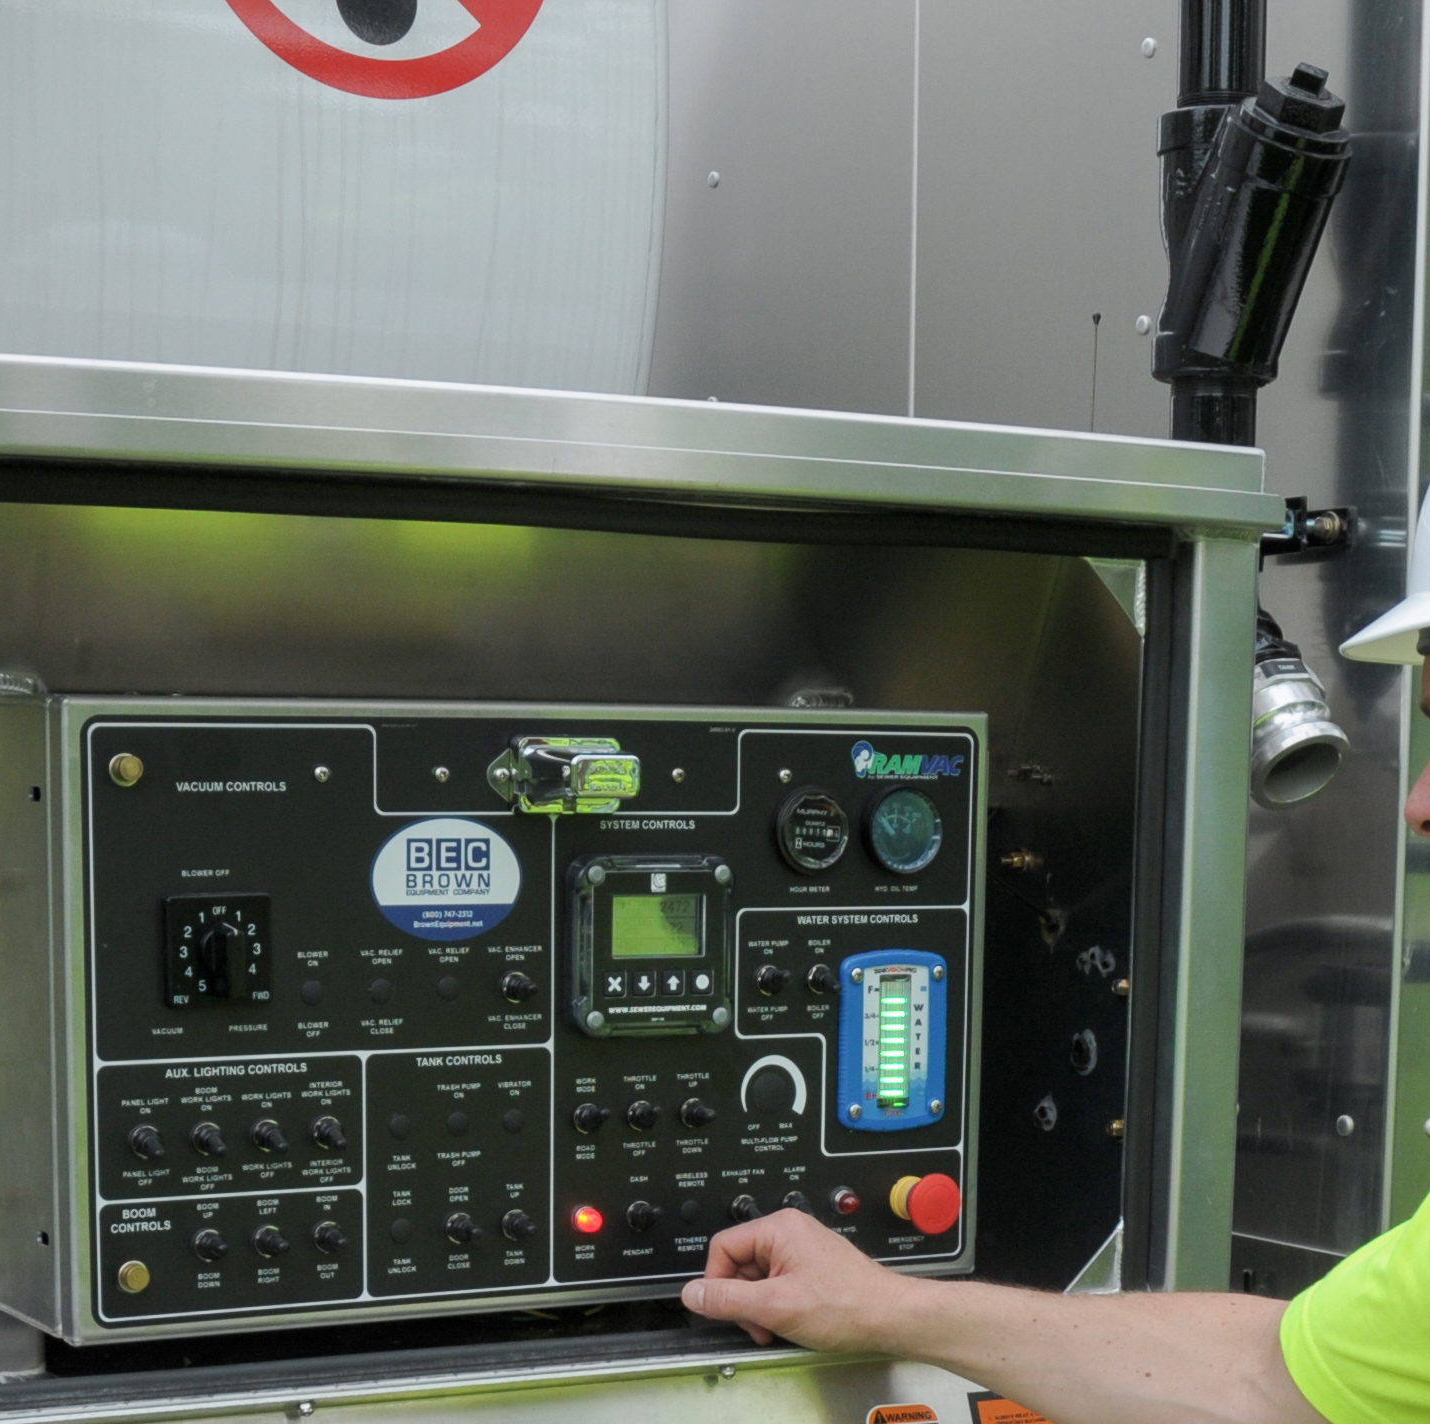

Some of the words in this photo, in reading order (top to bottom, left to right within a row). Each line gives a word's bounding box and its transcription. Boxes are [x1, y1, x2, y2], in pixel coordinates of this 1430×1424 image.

[869, 755, 963, 776] RAMVAC
[176, 782, 223, 792] VACUUM
[226, 782, 286, 792] CONTROLS
[600, 820, 639, 829] SYSTEM
[642, 820, 695, 829] CONTROLS
[408, 840, 489, 869] BEC
[406, 874, 490, 888] BROWN
[213, 906, 226, 915] OFF
[422, 911, 442, 919] (800)
[199, 913, 204, 923] 1
[236, 911, 241, 921] 1
[797, 916, 829, 925] WATER
[831, 915, 867, 924] SYSTEM
[870, 914, 918, 923] CONTROLS
[247, 924, 256, 935] 2
[413, 920, 483, 929] BrownEquipment.net
[184, 926, 192, 938] 2
[180, 947, 188, 958] 3
[253, 943, 261, 954] 3
[297, 951, 328, 959] BLOWER
[308, 959, 319, 967] ON
[184, 967, 193, 977] 4
[248, 964, 257, 974] 4
[198, 980, 206, 992] 5
[174, 995, 189, 1004] REV
[253, 991, 269, 1000] FWD
[152, 1027, 184, 1035] VACUUM
[229, 1024, 268, 1032] PRESSURE
[914, 1004, 924, 1070] WATER
[416, 1057, 444, 1067] TANK
[446, 1055, 502, 1065] CONTROLS
[165, 1069, 191, 1079] AUX.
[194, 1066, 245, 1077] LIGHTING
[248, 1063, 307, 1075] CONTROLS
[309, 1081, 343, 1089] INTERIOR
[387, 1163, 416, 1171] UNLOCK
[122, 1208, 156, 1219] BOOM
[259, 1207, 277, 1215] LEFT
[111, 1221, 171, 1233] CONTROLS
[675, 1236, 707, 1244] TETHERED
[623, 1248, 653, 1256] PENDANT
[886, 1411, 932, 1422] WARNING
